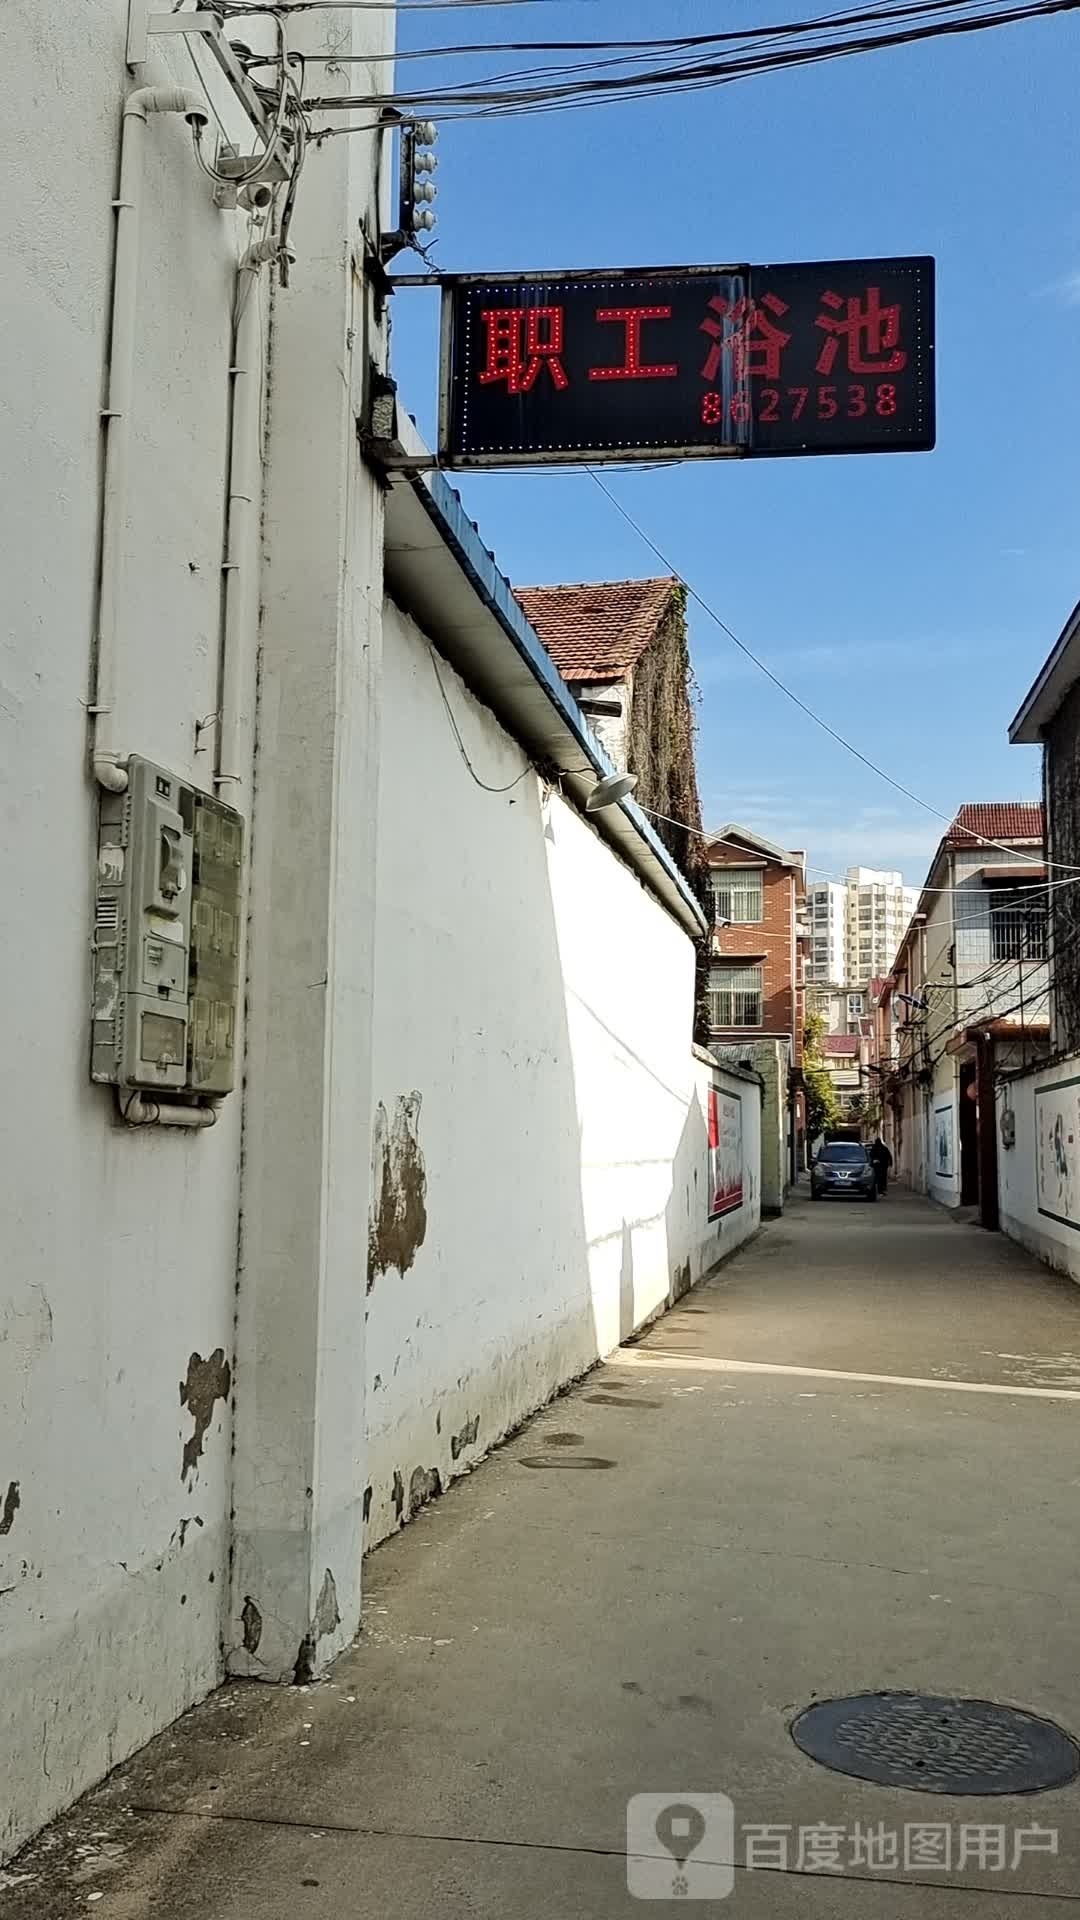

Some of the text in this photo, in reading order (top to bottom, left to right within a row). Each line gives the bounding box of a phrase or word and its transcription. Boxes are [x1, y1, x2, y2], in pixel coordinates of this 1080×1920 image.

[479, 287, 907, 394] 职工浴池
[701, 383, 898, 425] 8627538
